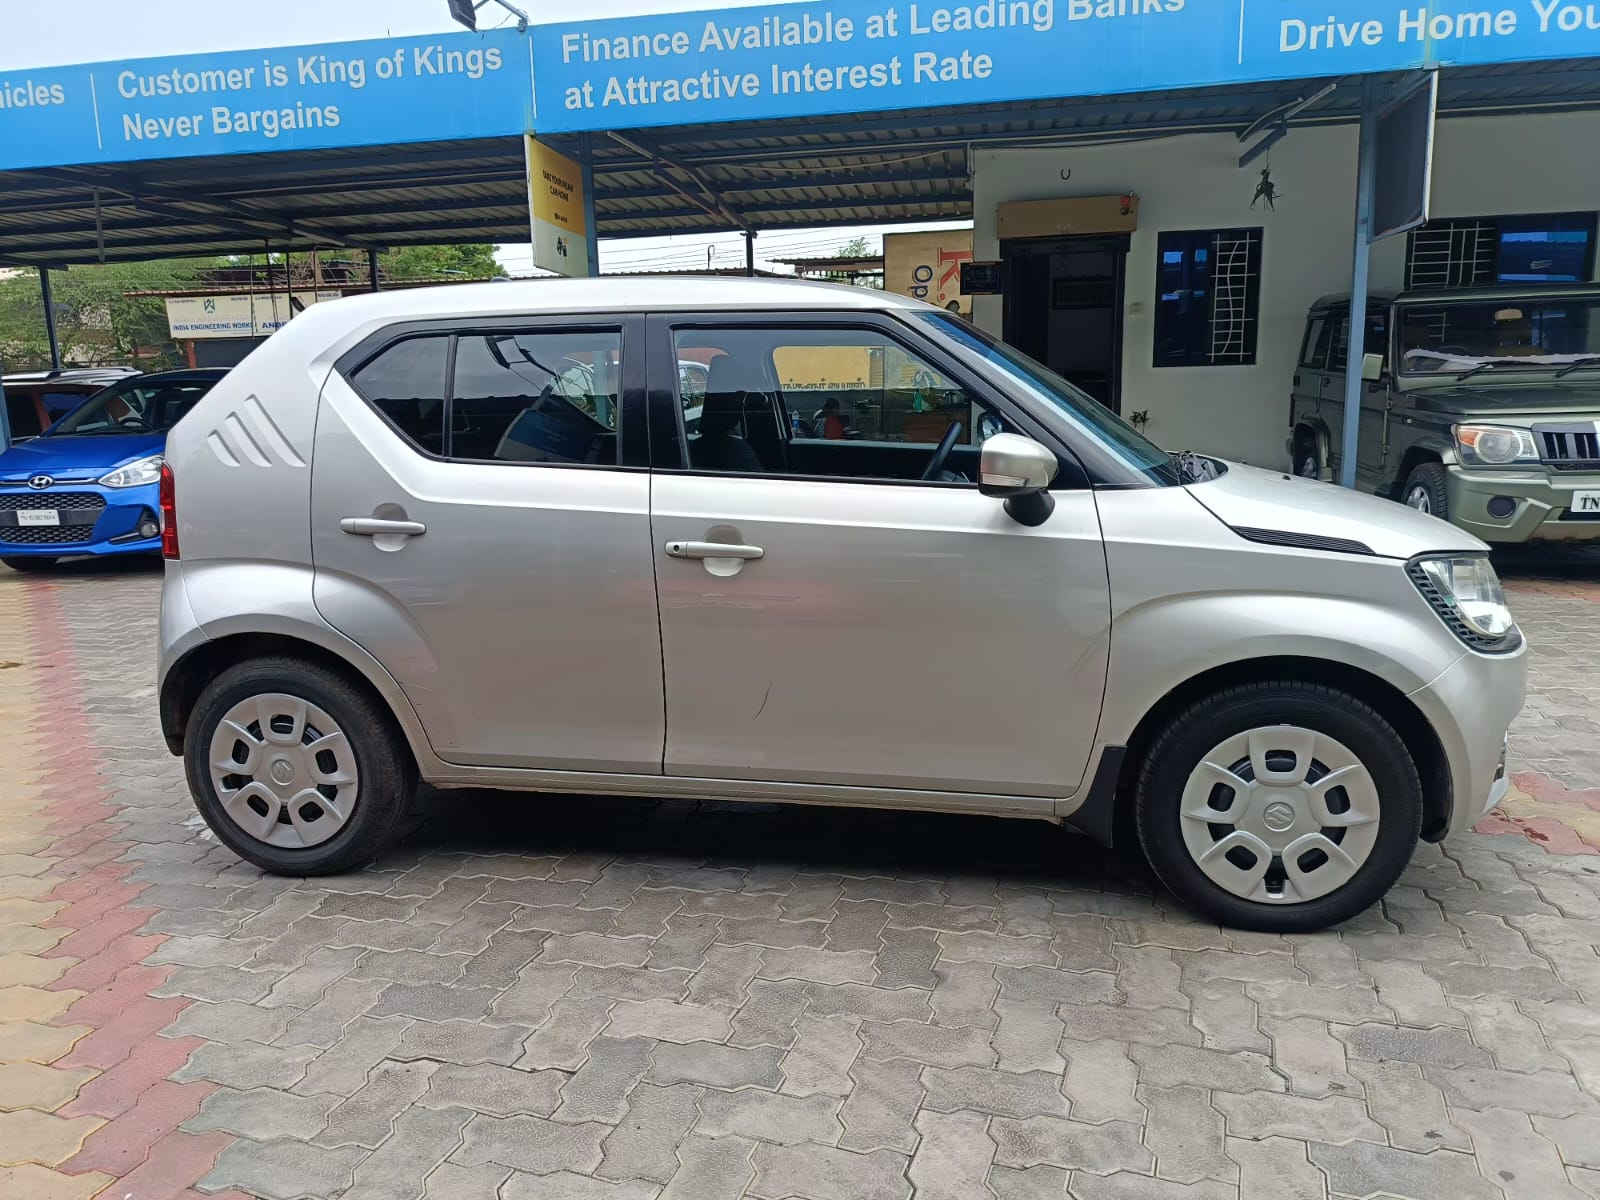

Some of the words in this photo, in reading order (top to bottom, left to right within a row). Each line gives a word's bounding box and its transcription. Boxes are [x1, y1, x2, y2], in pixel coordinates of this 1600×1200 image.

[562, 31, 691, 64] Finance
[698, 11, 855, 52] Available
[865, 7, 898, 39] at
[910, 0, 1055, 35] Leading
[1279, 15, 1384, 52] Drive
[1398, 8, 1518, 43] Home
[117, 67, 257, 99] Customer
[263, 59, 289, 87] is
[297, 55, 366, 89] King
[375, 48, 405, 79] of
[413, 45, 503, 79] Kings
[564, 80, 594, 110] at
[602, 68, 760, 107] Attractive
[772, 56, 902, 95] Interest
[914, 49, 993, 83] Rate
[123, 113, 205, 141] Never
[211, 101, 340, 138] Bargains
[909, 265, 934, 302] Op
[190, 322, 231, 330] ENGINEERING
